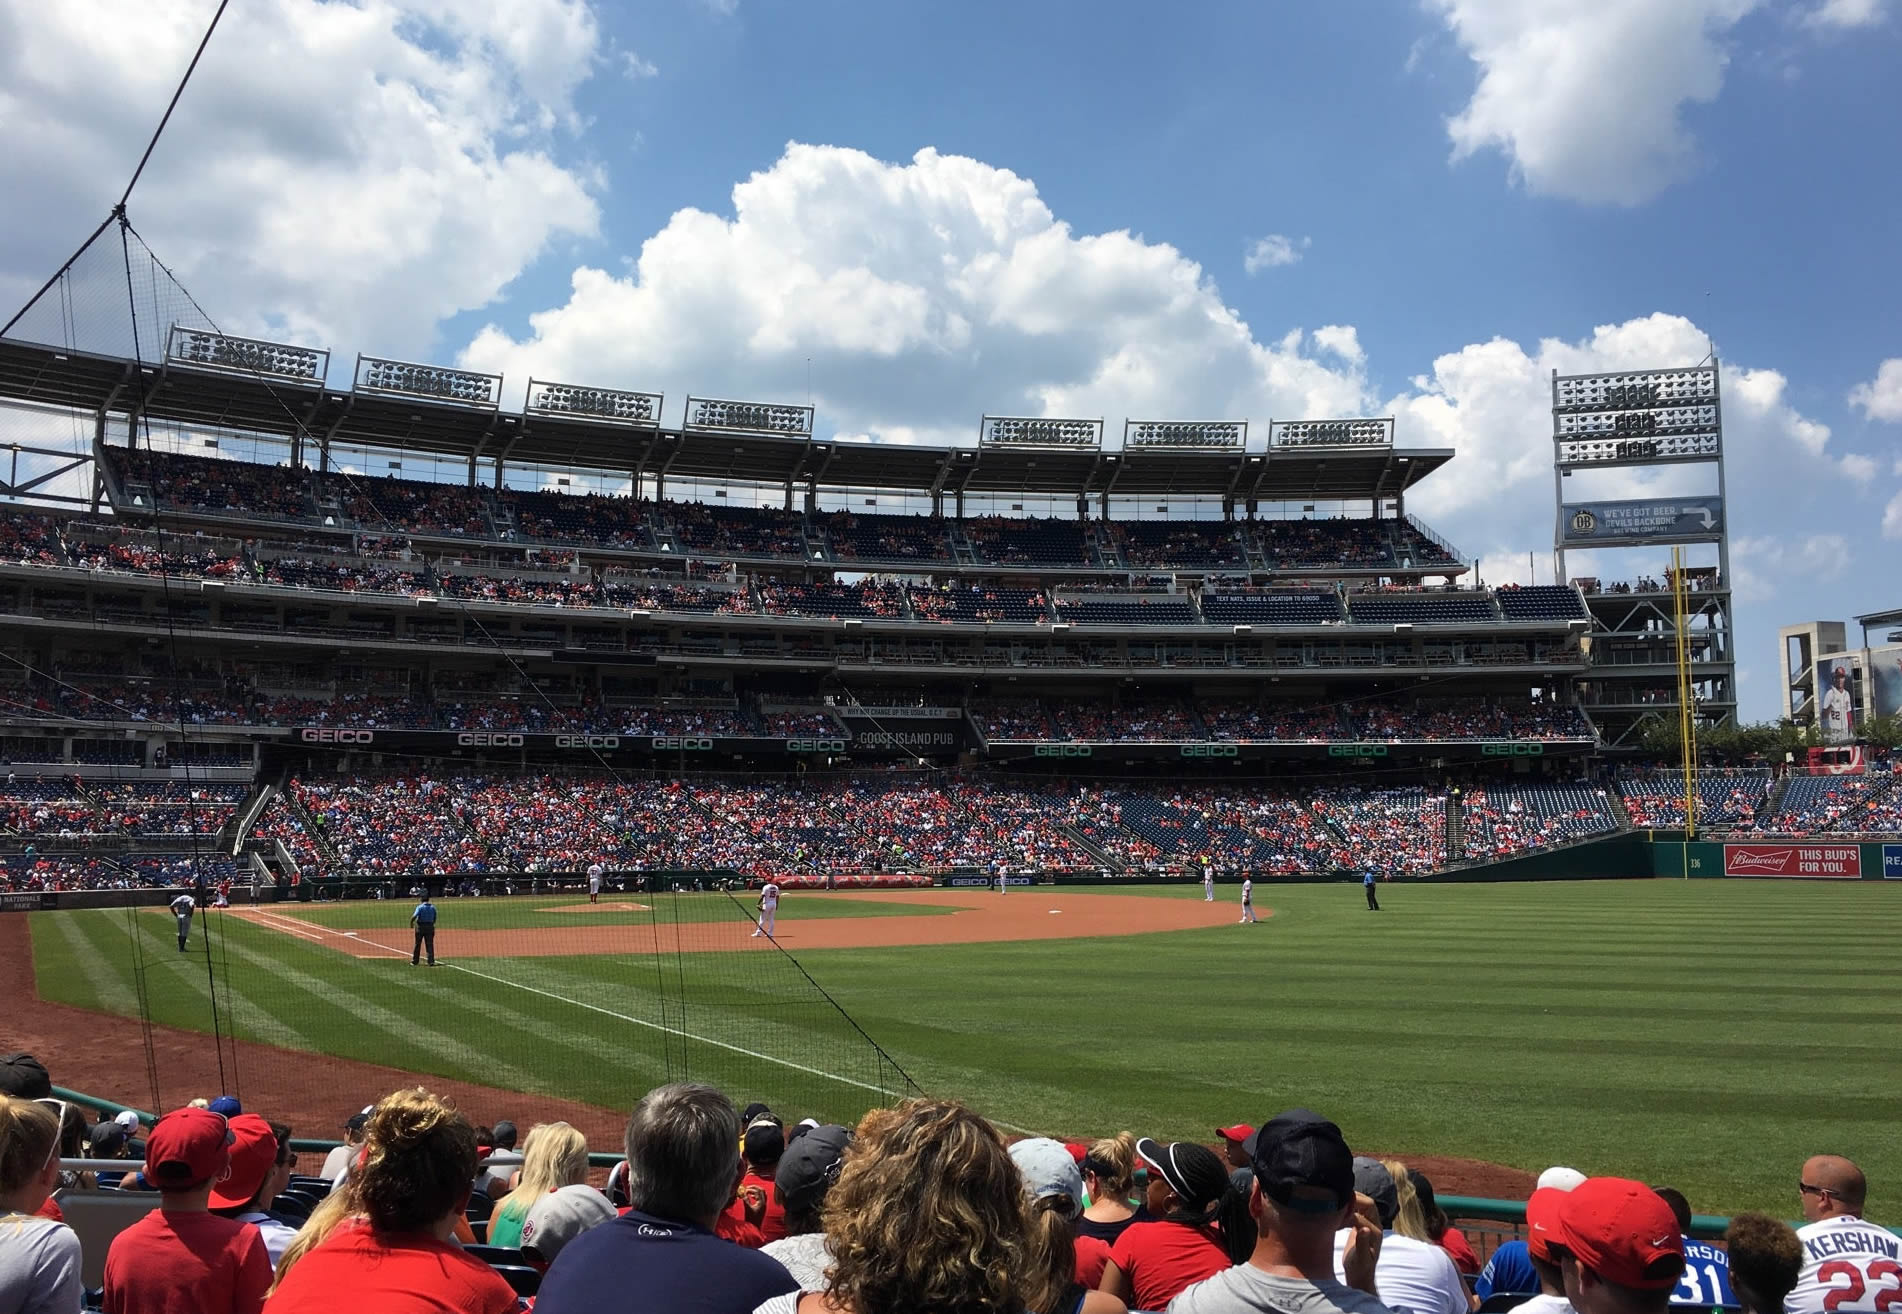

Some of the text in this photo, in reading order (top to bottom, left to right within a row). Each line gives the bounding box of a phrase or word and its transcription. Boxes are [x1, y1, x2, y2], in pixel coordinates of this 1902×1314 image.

[1604, 509, 1632, 518] WE'VE
[1633, 508, 1650, 517] GOT
[1576, 515, 1591, 528] DB
[1605, 516, 1677, 527] DEVILS BACKBONE
[847, 707, 859, 716] WHY
[871, 708, 891, 717] CHANGE
[900, 708, 910, 717] THE
[302, 729, 373, 744] GEICO
[458, 733, 524, 747] GEICO
[555, 736, 620, 748] GEICO
[860, 732, 954, 745] GOOSE ISLAND PUB
[652, 738, 713, 750] GEICO
[787, 740, 845, 751] GEICO
[1482, 743, 1543, 755] GEICO
[1035, 746, 1092, 756] GEICO
[1181, 746, 1238, 756] GEICO
[1329, 745, 1388, 756] GEICO
[1733, 854, 1786, 866] Budweiser
[1799, 850, 1857, 861] THIS BUD'S
[1885, 856, 1902, 865] RE
[1799, 862, 1847, 873] FOR YOU.
[952, 878, 988, 886] GEICO
[1805, 1231, 1900, 1261] KERSHAW
[1684, 1245, 1729, 1269] RSO
[1669, 1265, 1723, 1305] 31
[1816, 1260, 1902, 1312] 22
